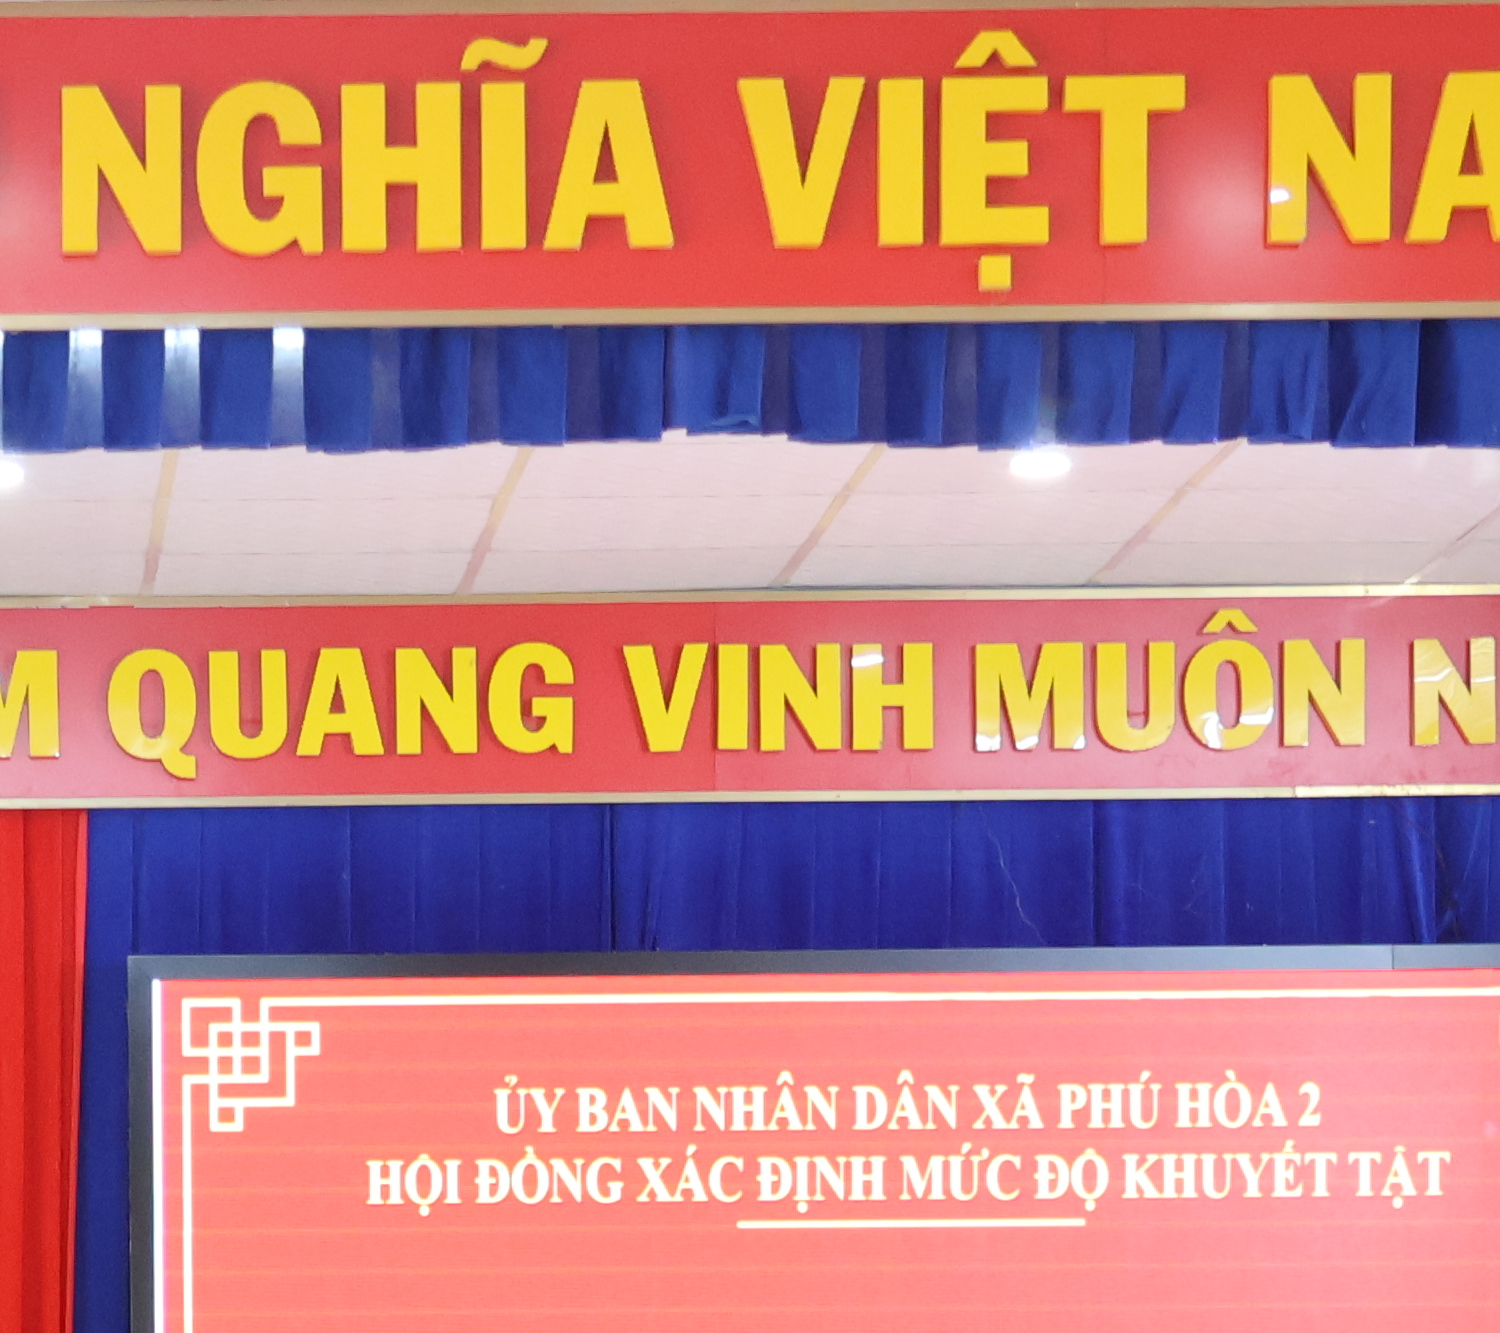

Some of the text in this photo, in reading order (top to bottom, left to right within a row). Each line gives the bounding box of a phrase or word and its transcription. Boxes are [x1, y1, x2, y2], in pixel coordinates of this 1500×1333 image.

[61, 38, 674, 254] NGHĨA
[738, 30, 1186, 290] VIỆT
[107, 642, 574, 778] QUANG
[623, 642, 935, 752] VINH
[975, 608, 1367, 751] MUÔN
[494, 1070, 1321, 1133] ỦY BAN NHÂN DÂN XÃ PHÚ HÒA 2
[367, 1140, 1451, 1216] HỘI ĐỒNG XÁC ĐỊNH MỨC ĐỘ KHUYẾT TẬT
